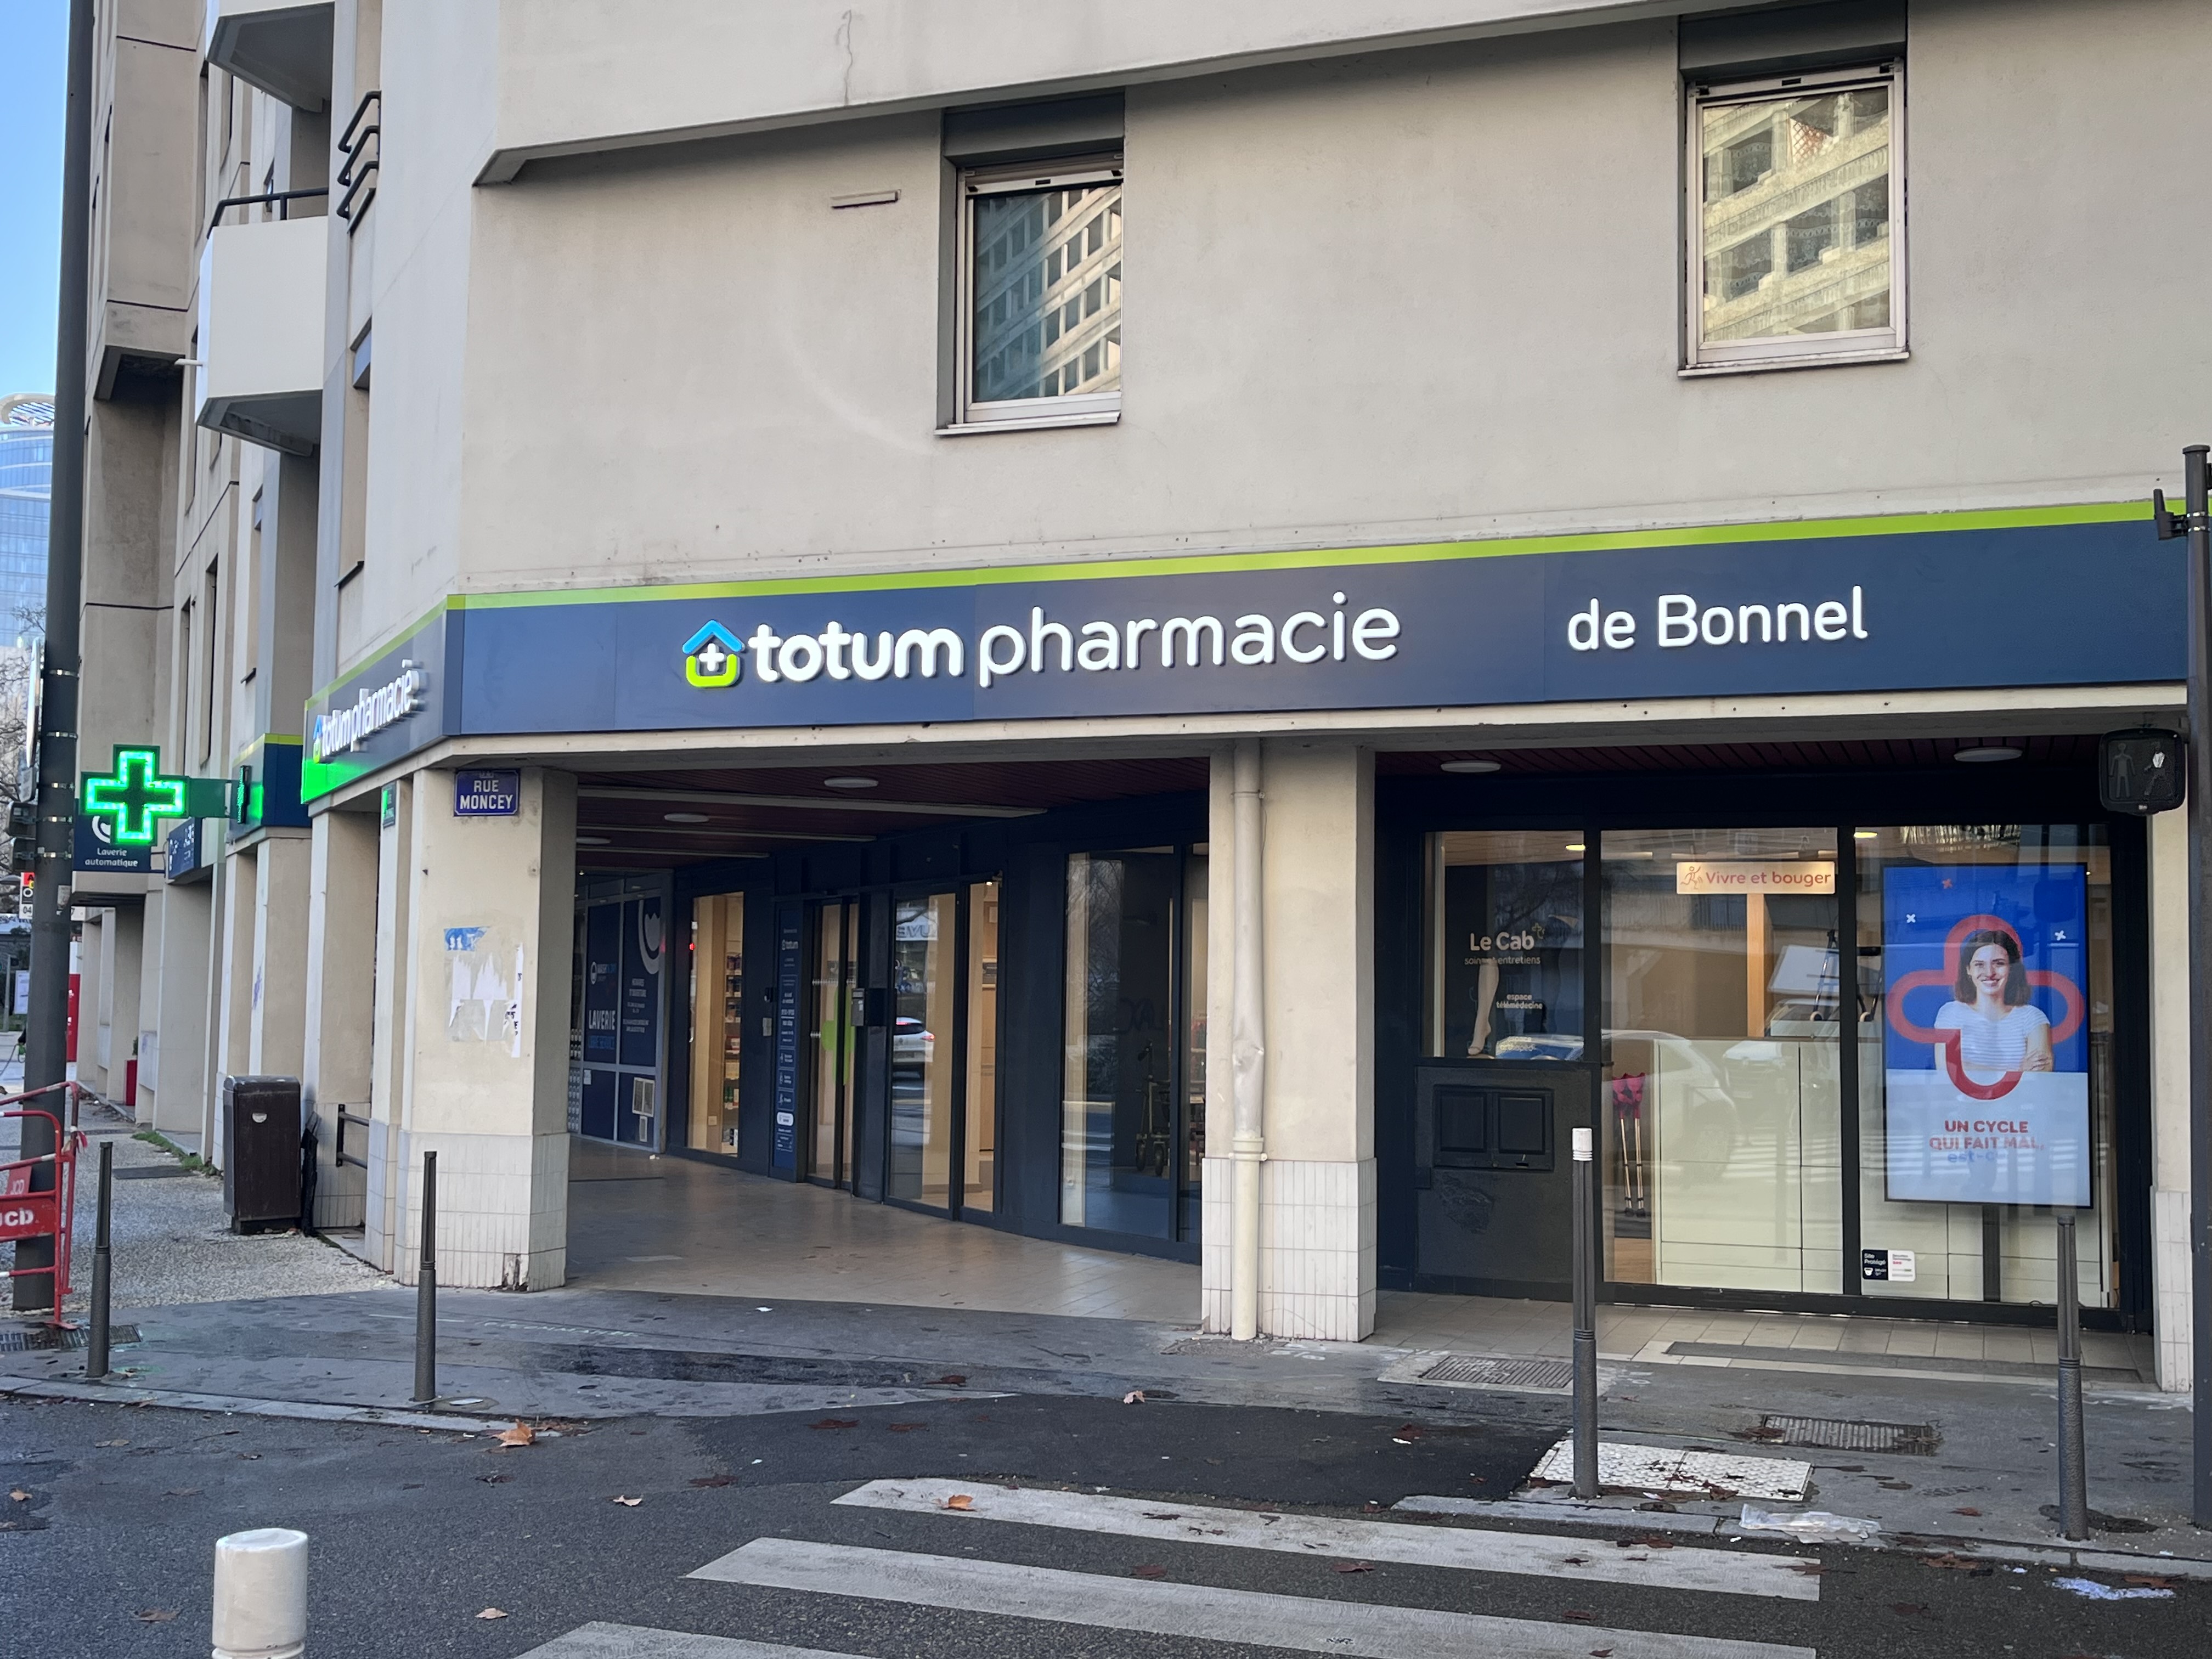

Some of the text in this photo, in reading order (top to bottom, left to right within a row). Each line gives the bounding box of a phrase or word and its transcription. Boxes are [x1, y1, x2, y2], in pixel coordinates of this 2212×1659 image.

[1568, 585, 1868, 651] de Bonnel
[748, 591, 1401, 688] totum pharmacie
[321, 659, 420, 757] totum pharmacie
[473, 780, 499, 793] RUE
[460, 794, 514, 810] MONCEY
[97, 848, 128, 856] Laverie
[84, 858, 138, 867] automatique
[1706, 871, 1831, 887] Vivre et bouger
[1470, 930, 1535, 951] Le Cab
[1498, 956, 1541, 965] entretiens
[1496, 1001, 1543, 1009] télémédecine
[589, 1010, 616, 1030] LAVERIE
[1944, 1120, 2028, 1133] UN CYCLE
[1929, 1137, 1959, 1150] QUI
[1964, 1137, 2000, 1149] FAIT
